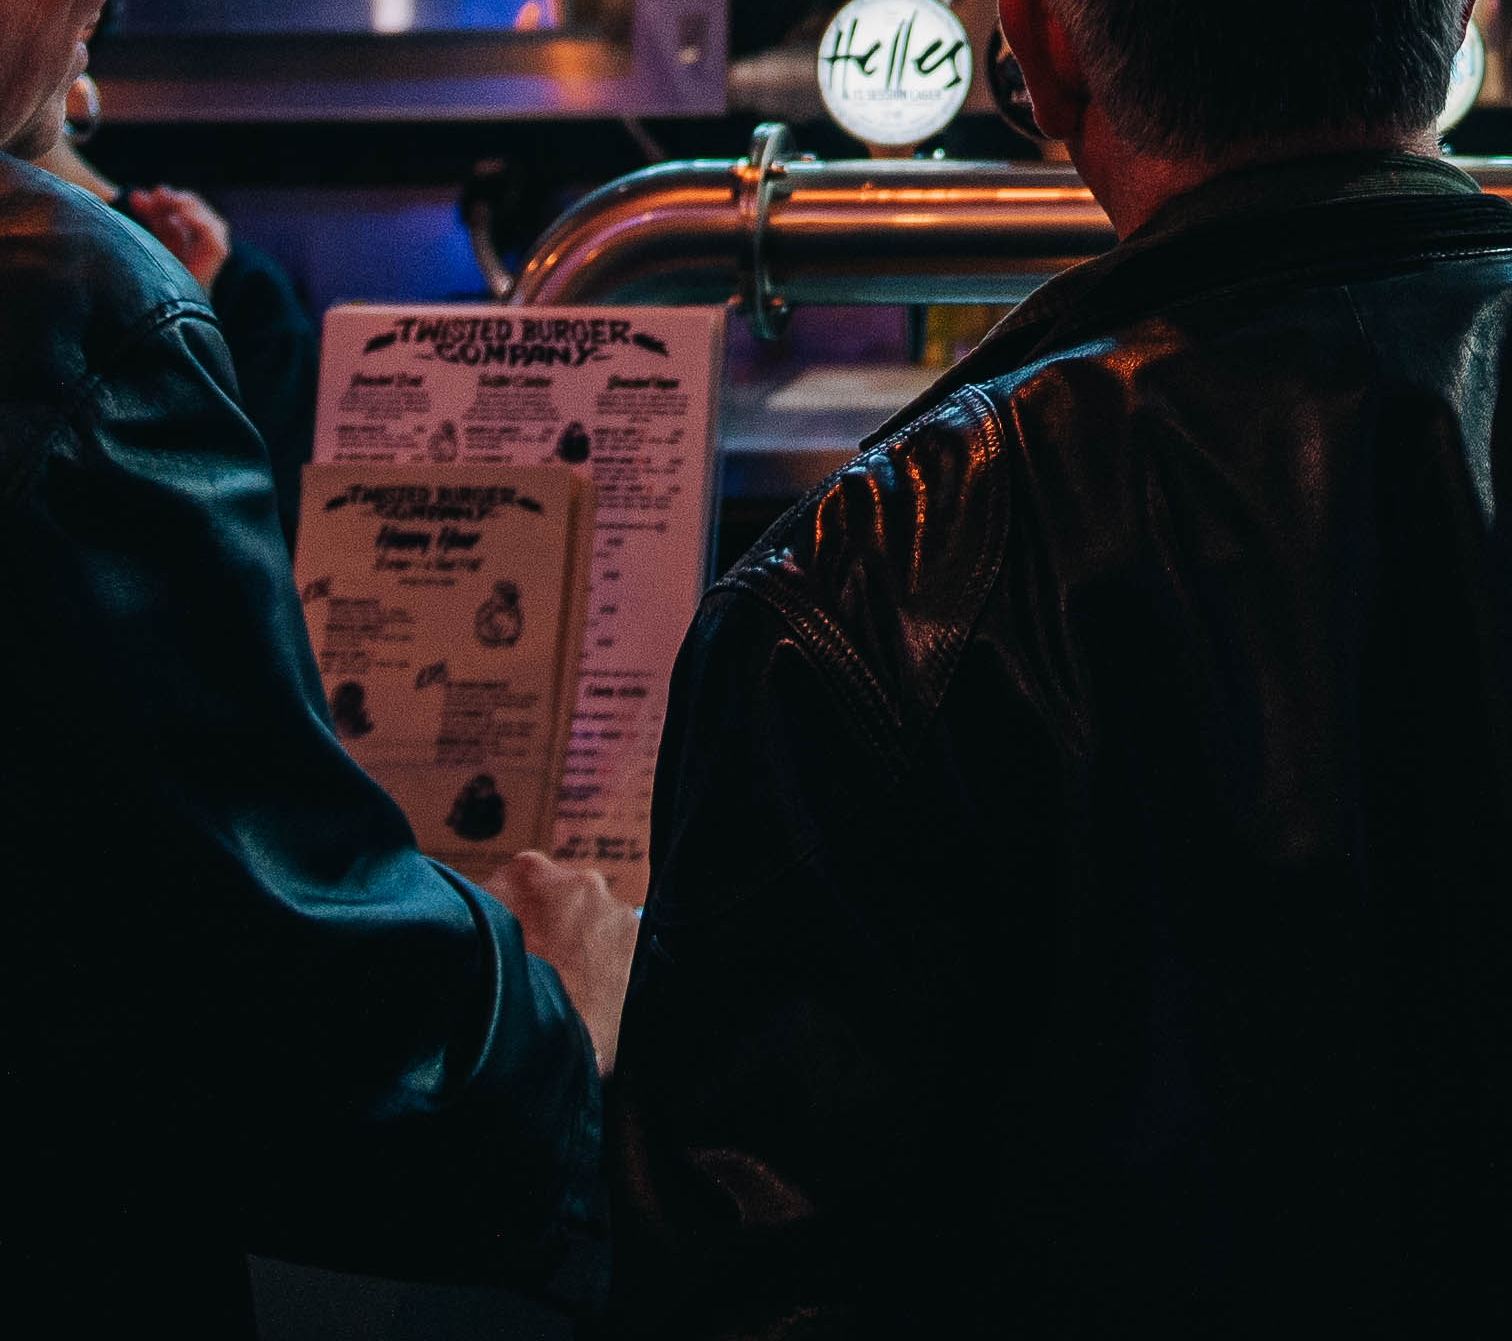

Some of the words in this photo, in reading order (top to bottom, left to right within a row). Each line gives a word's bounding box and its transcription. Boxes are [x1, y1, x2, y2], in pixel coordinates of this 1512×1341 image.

[396, 317, 515, 345] TWISTED
[520, 318, 634, 346] BURGER
[435, 342, 595, 368] COMPANY
